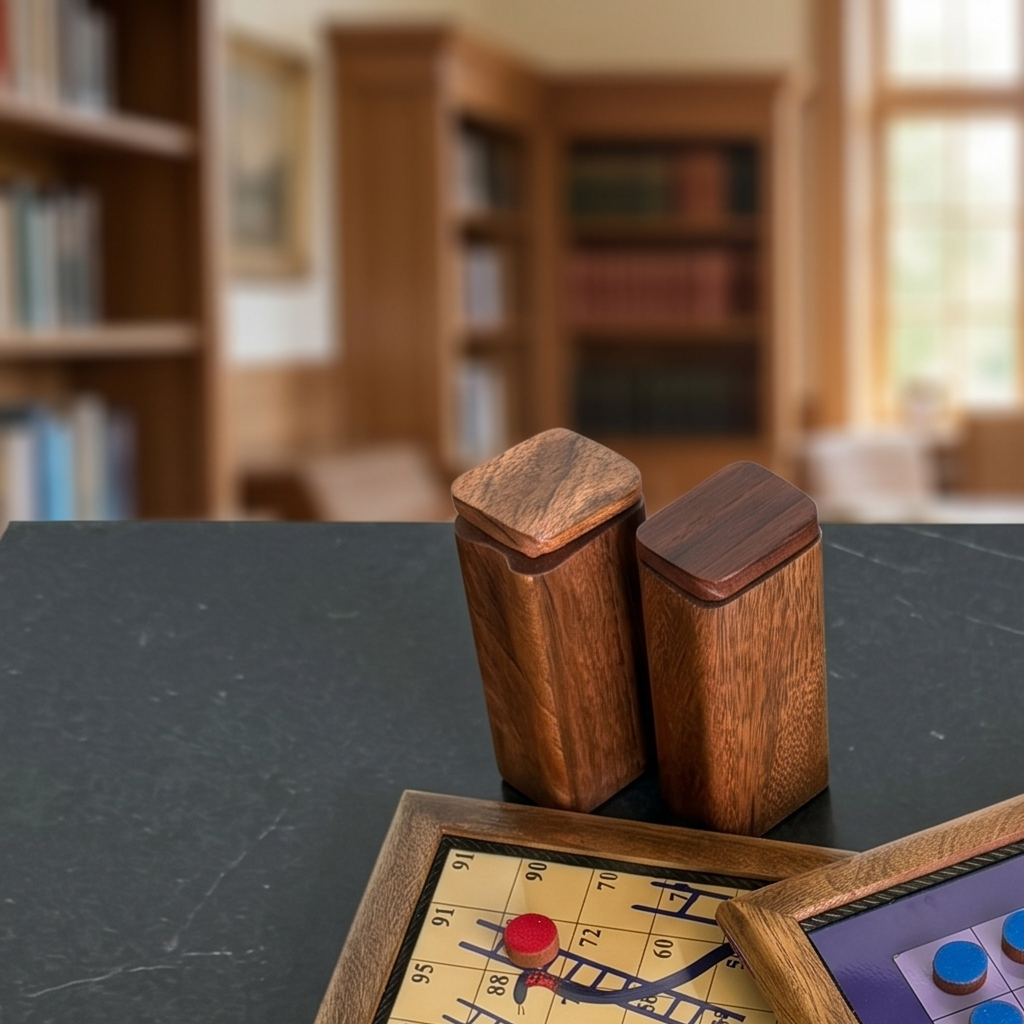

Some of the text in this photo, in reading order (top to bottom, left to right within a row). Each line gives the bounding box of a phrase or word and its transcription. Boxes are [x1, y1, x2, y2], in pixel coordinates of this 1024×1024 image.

[452, 852, 475, 871] 91
[525, 862, 548, 882] 90
[597, 872, 618, 891] 70
[431, 907, 455, 927] 91
[579, 928, 601, 947] 72
[654, 939, 674, 959] 60
[411, 963, 434, 985] 95
[487, 974, 509, 996] 88
